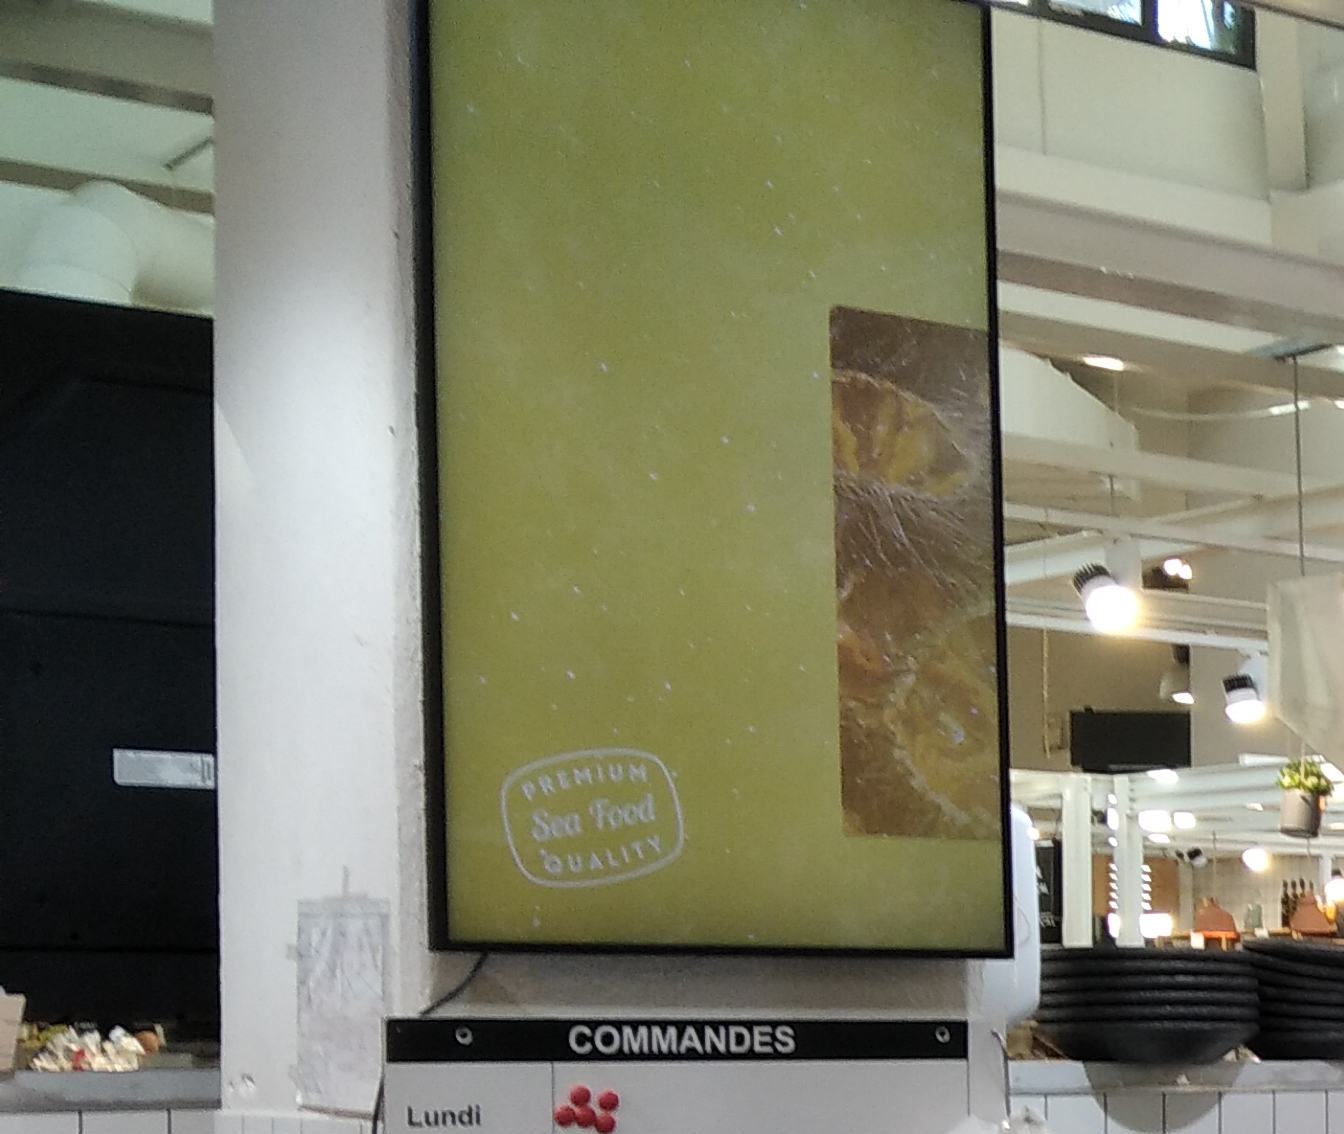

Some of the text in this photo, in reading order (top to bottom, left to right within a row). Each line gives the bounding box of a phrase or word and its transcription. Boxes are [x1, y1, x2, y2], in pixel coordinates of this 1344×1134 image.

[521, 764, 647, 802] PREMIUM
[532, 792, 655, 842] Sea Food
[543, 834, 661, 874] QUALITY
[568, 1024, 797, 1056] COMMANDES
[407, 1104, 482, 1128] Lundi
